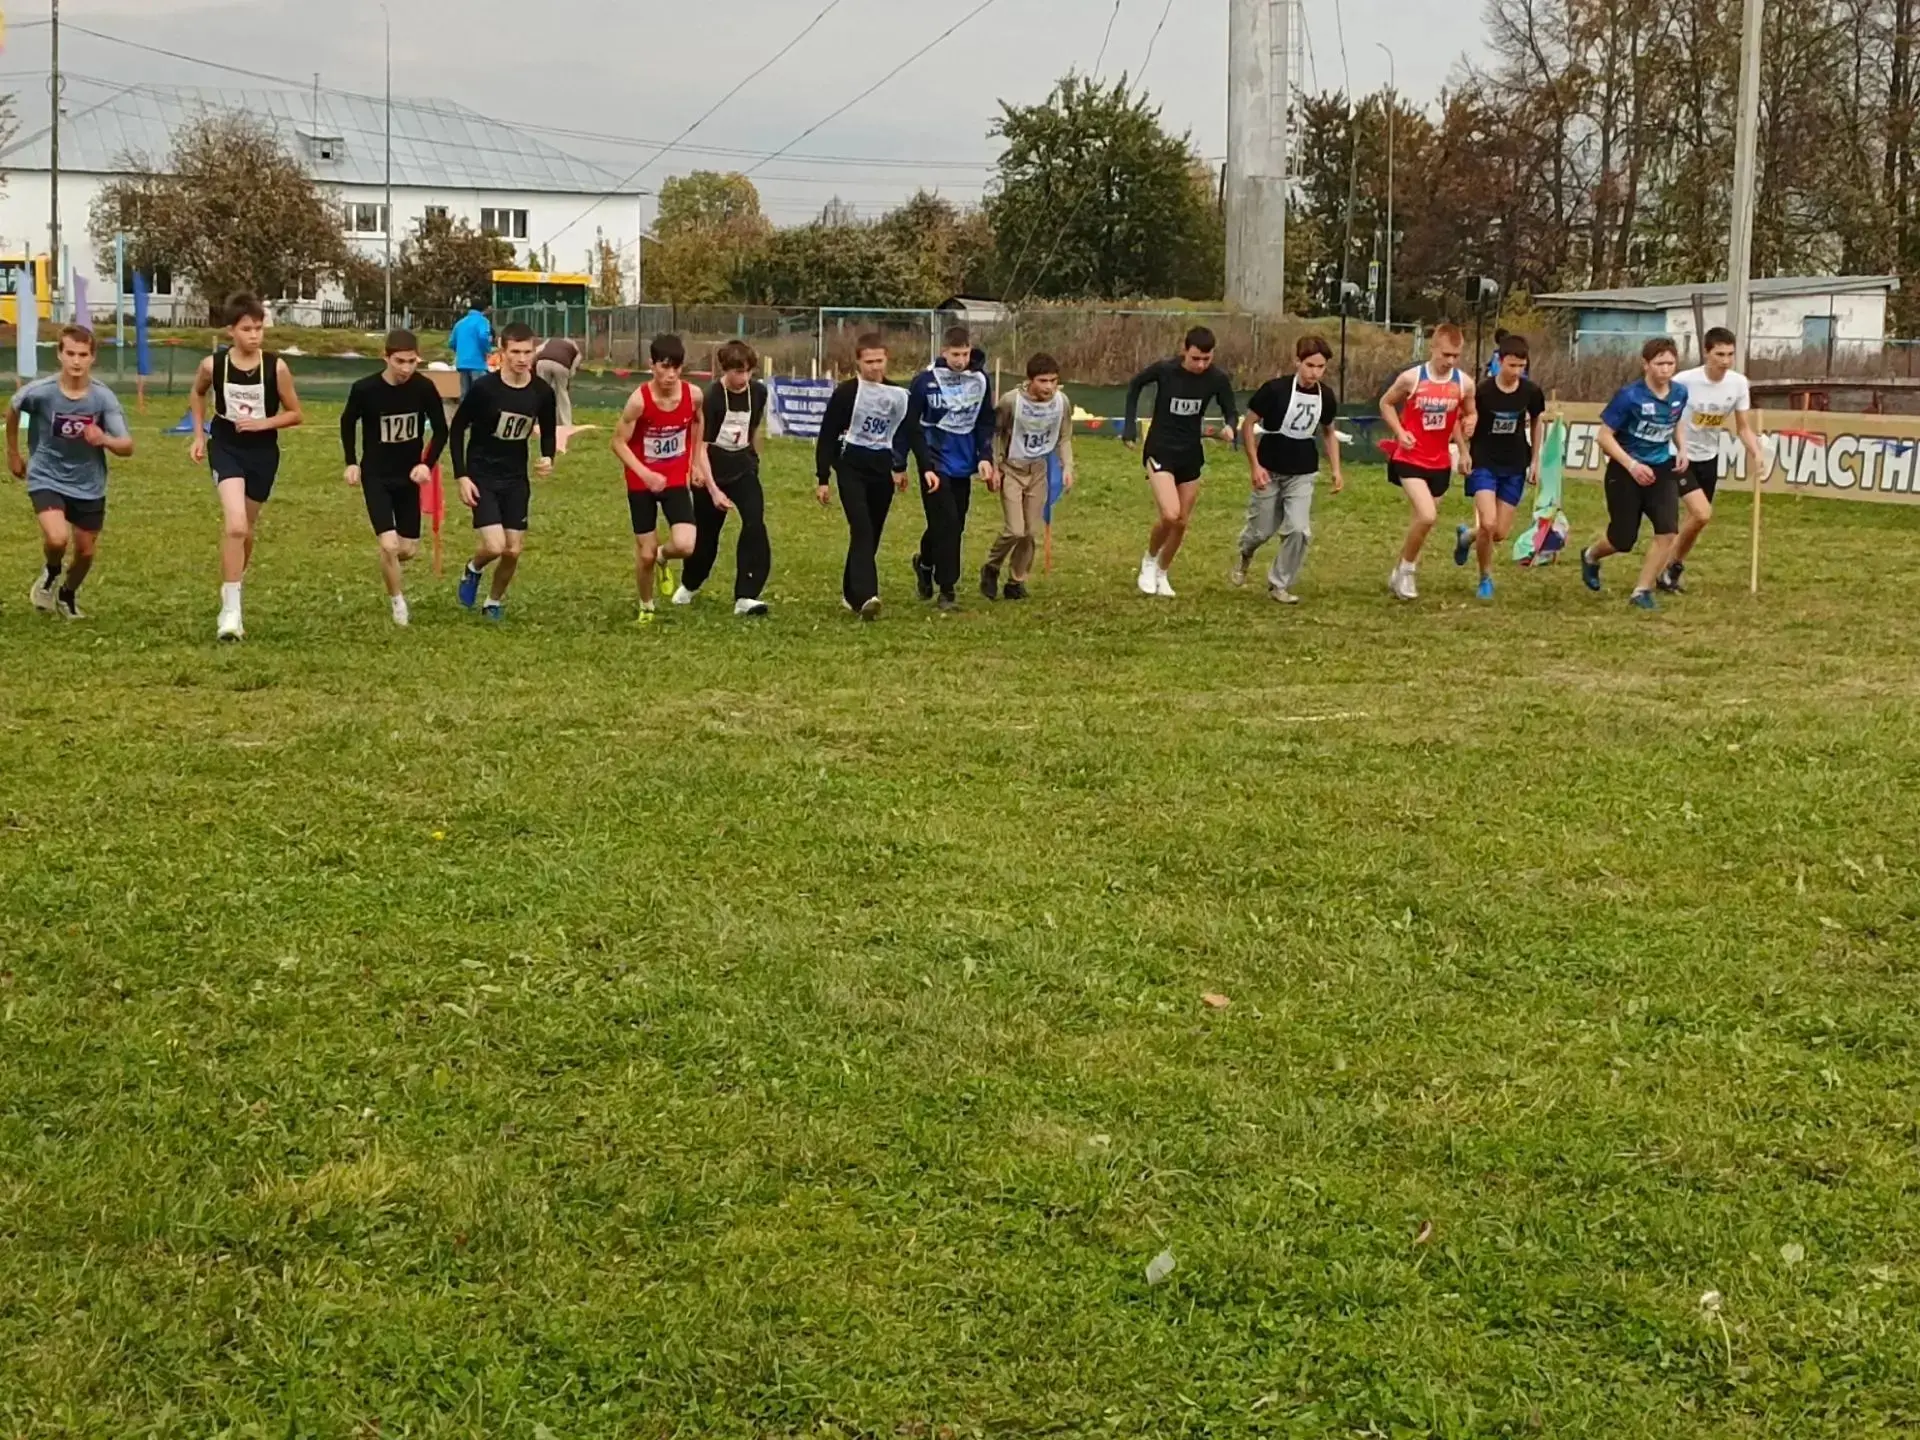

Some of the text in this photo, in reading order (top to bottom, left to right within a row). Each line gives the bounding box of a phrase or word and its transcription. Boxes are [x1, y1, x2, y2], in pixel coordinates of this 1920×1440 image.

[383, 415, 416, 442] 120
[1290, 402, 1315, 431] 25
[653, 437, 679, 455] 340
